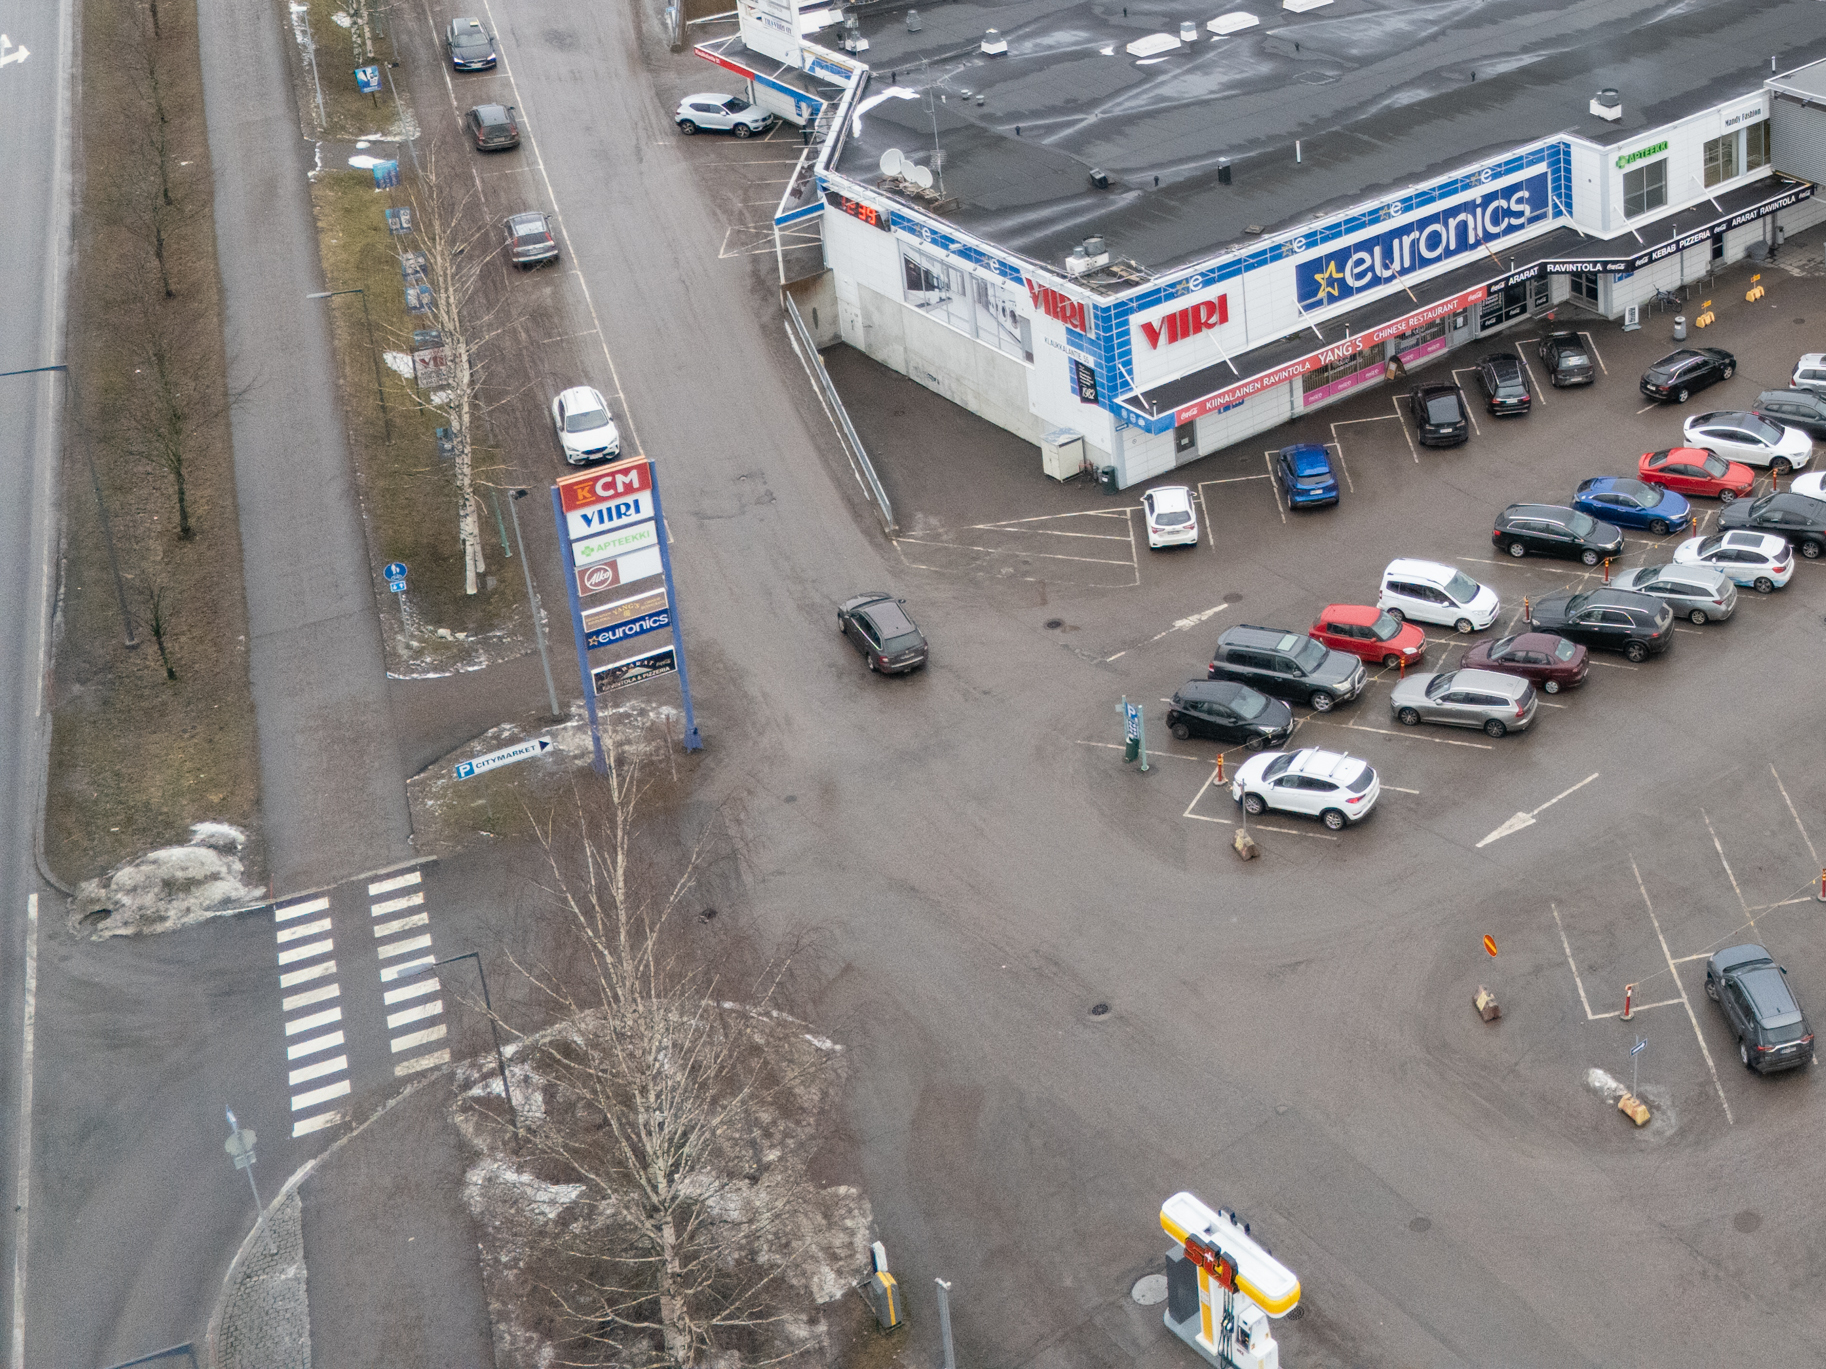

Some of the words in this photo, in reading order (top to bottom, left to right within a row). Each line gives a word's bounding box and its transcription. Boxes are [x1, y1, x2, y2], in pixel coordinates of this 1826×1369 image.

[1627, 141, 1668, 164] APTEEKKI
[1731, 211, 1758, 227] ARARAT
[1760, 195, 1796, 216] RAVINTOLA
[1345, 189, 1531, 288] euronics
[1652, 244, 1677, 260] KEBAB
[1679, 230, 1710, 248] PIZZERIA
[1508, 267, 1539, 286] ARARAT
[1547, 263, 1602, 272] RAVINTOLA
[1025, 277, 1086, 333] VIIRI
[1140, 293, 1229, 350] VIIRI
[1206, 381, 1261, 410] KIINALAINEN
[1263, 362, 1311, 386] RAVINTOLA
[1373, 322, 1407, 341] CHINESE
[1409, 300, 1458, 328] RESTAURANT
[580, 498, 641, 528] VIIRI
[596, 530, 650, 553] APTEEKKI
[588, 570, 610, 585] Alko
[598, 614, 668, 643] euronics
[642, 666, 670, 678] PIZZERIA
[459, 764, 471, 778] P
[476, 744, 536, 769] CITYMARKET
